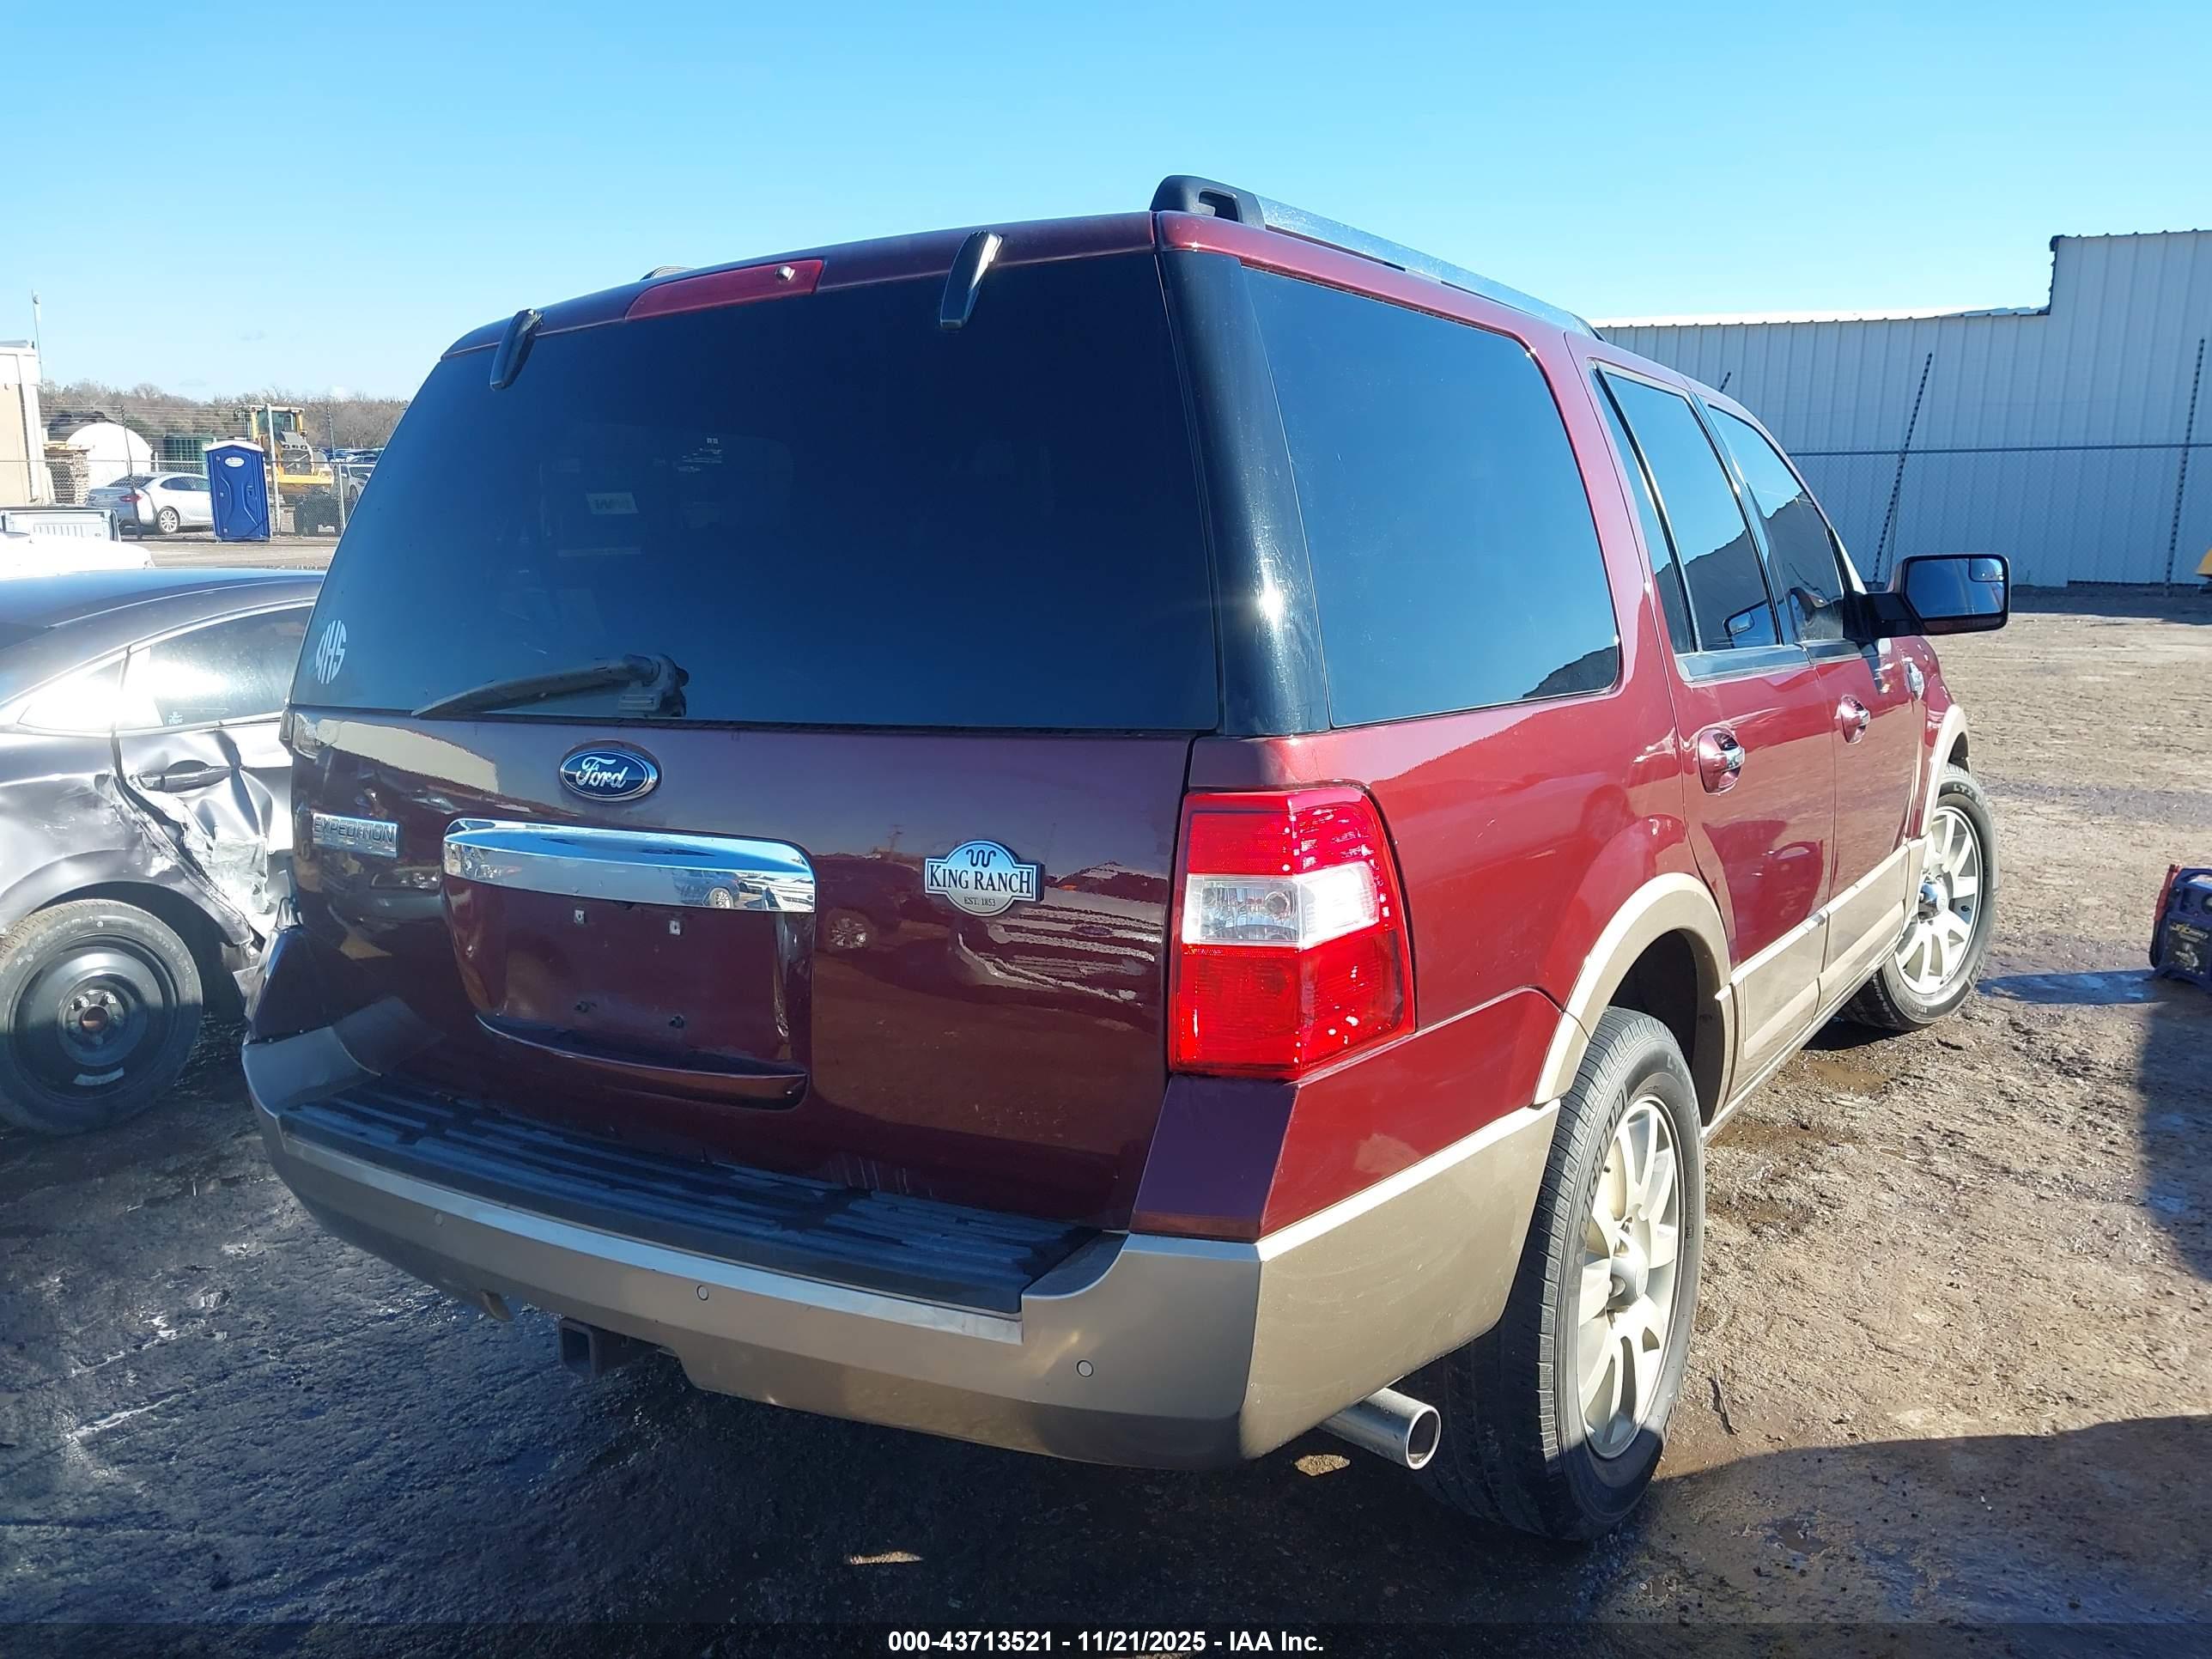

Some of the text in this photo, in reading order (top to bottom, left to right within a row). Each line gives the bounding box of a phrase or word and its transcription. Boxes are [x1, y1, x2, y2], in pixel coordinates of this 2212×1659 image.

[575, 756, 629, 788] Ford
[313, 816, 396, 843] EXPEDITION
[929, 864, 1032, 895] KING RANCH
[963, 896, 996, 907] EST. 1853
